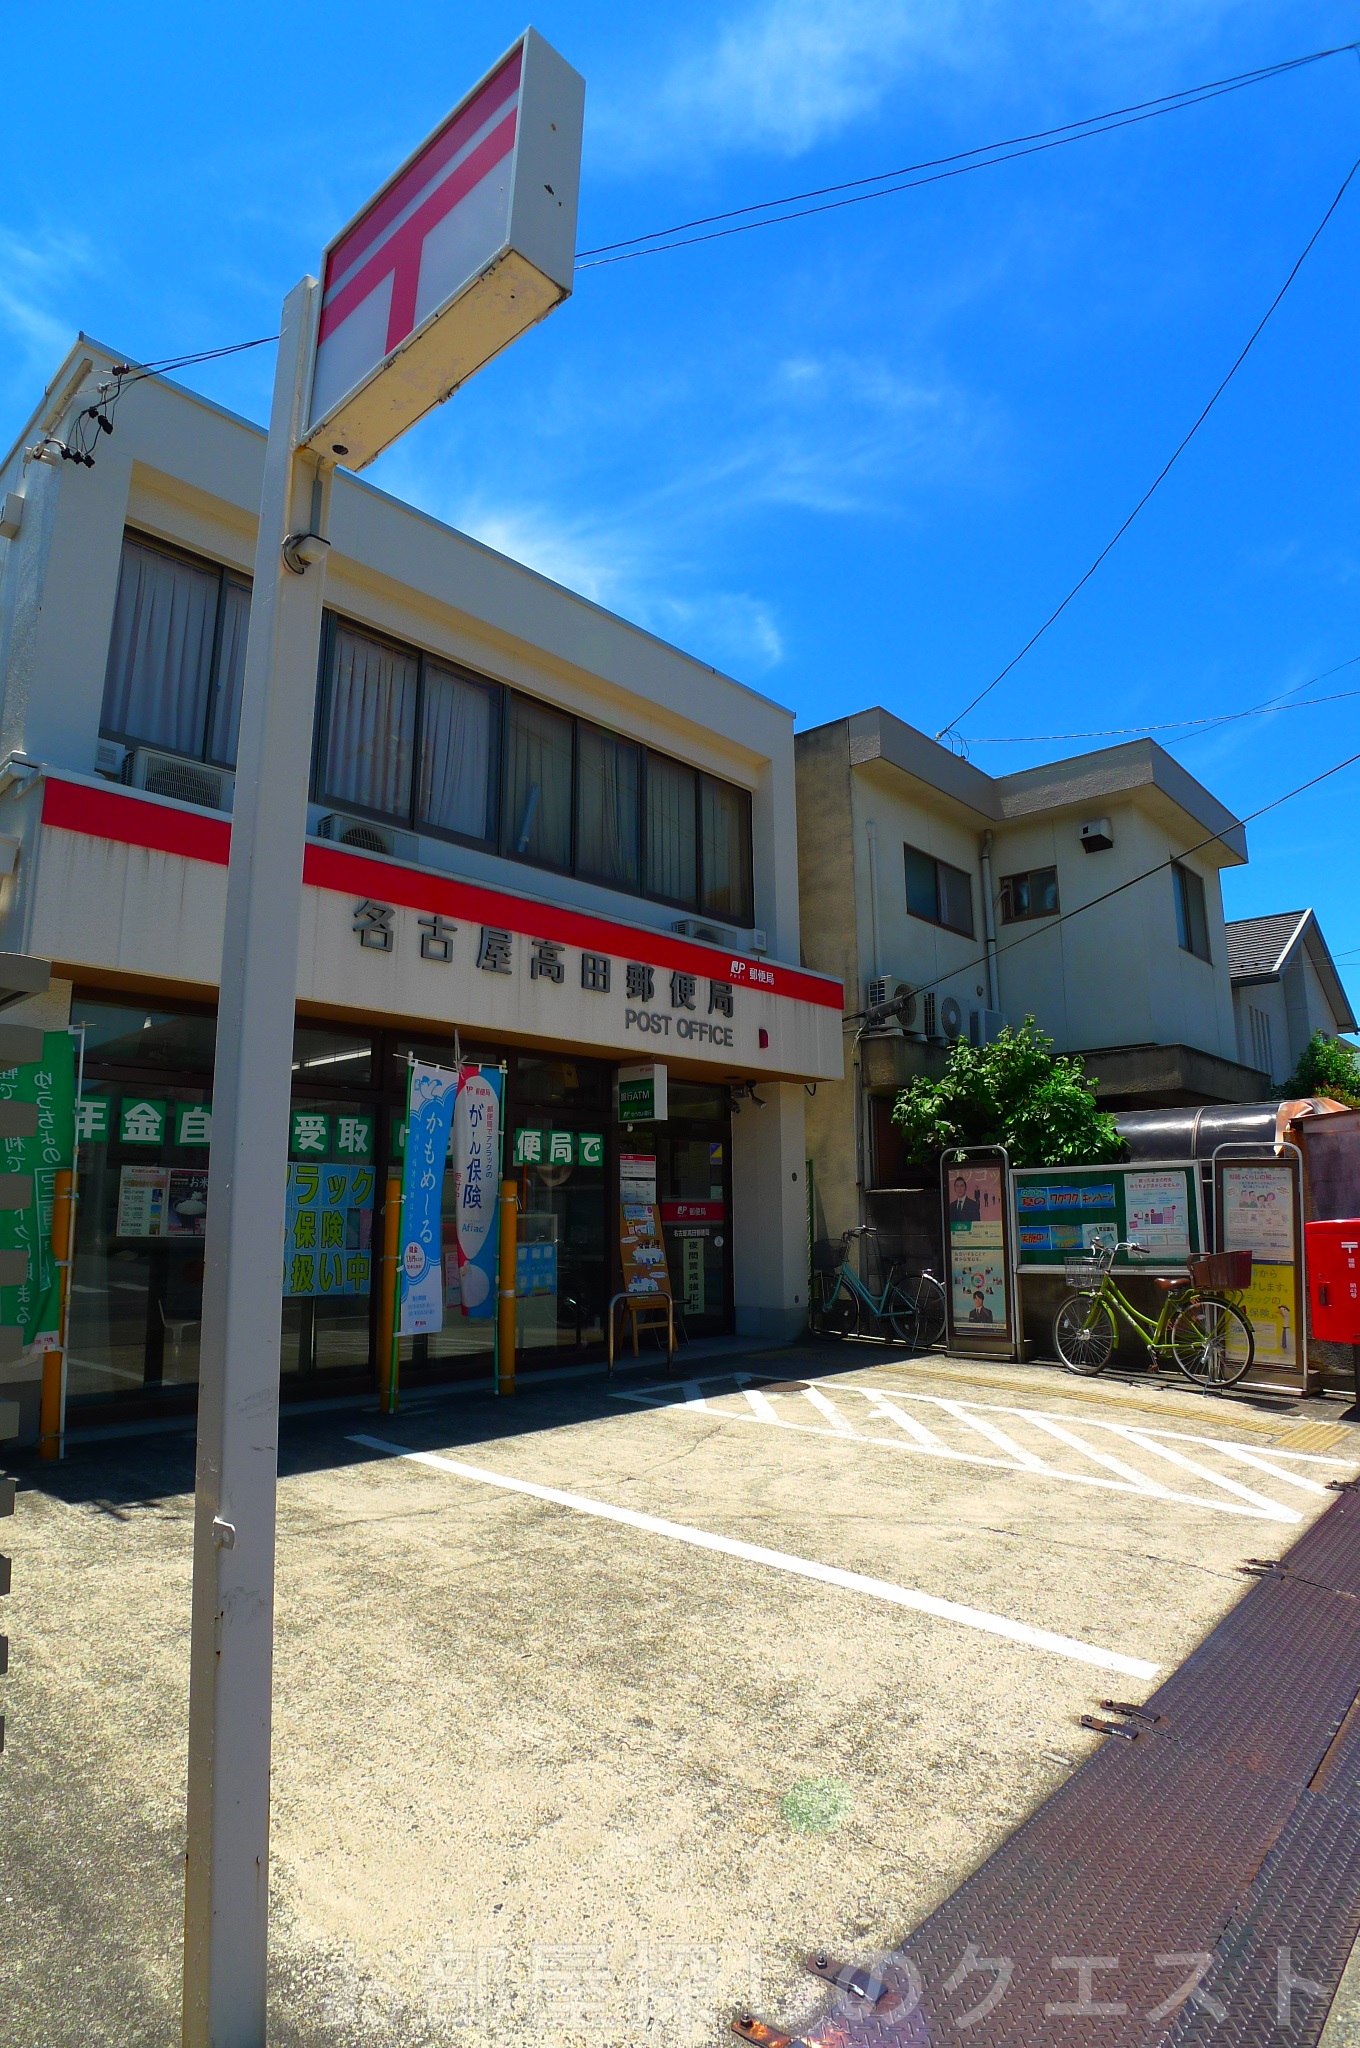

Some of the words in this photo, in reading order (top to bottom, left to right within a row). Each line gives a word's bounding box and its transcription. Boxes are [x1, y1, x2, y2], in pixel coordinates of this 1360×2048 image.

[352, 898, 735, 1019] 名古屋高田郵便局
[749, 967, 775, 985] 郵便局
[624, 1009, 673, 1036] POST
[676, 1020, 735, 1047] OFFICE
[419, 1111, 443, 1244] かもめーる
[462, 1103, 485, 1209] がん保険
[287, 1165, 374, 1206] ラック
[461, 1223, 484, 1233] Aflac
[688, 1241, 699, 1312] 夜間警戒強化中
